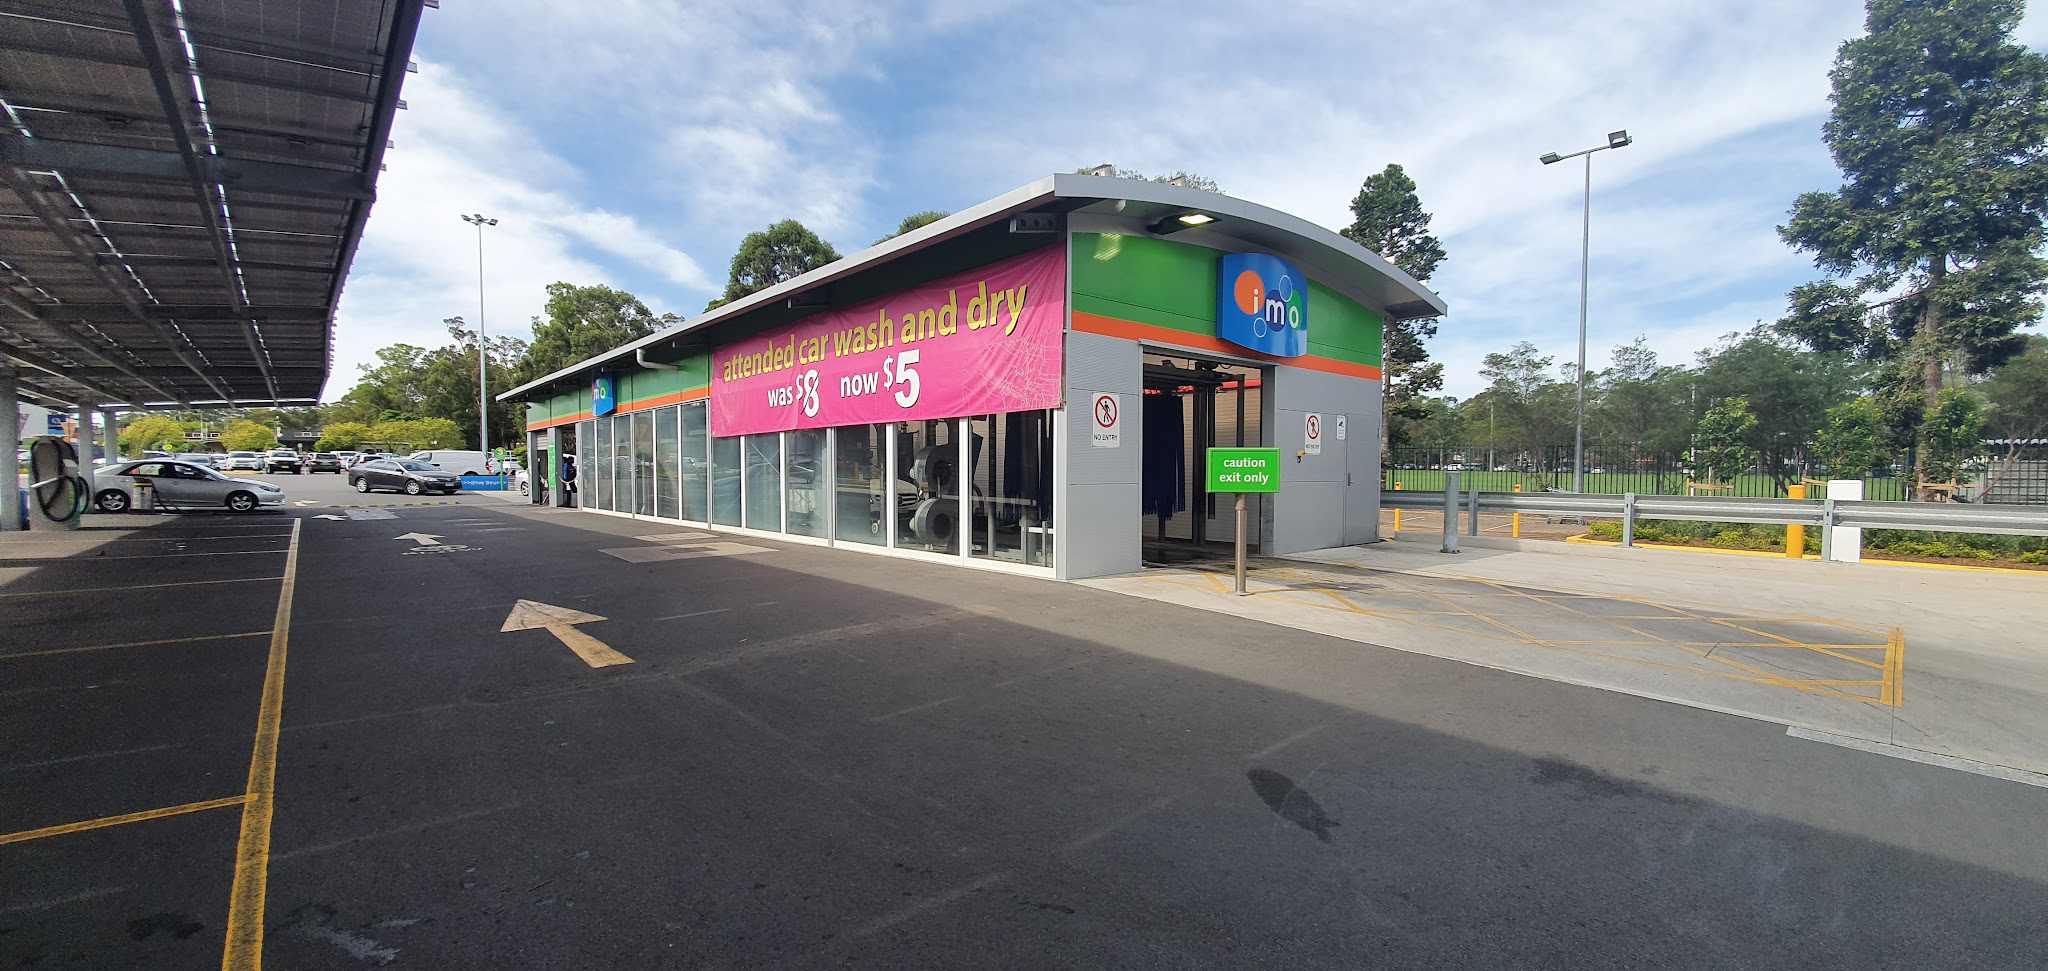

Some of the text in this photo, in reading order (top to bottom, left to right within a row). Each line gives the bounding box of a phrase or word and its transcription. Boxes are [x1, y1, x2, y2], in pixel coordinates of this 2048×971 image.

[1253, 288, 1299, 328] imo
[723, 280, 1028, 383] attended car wash and dry
[767, 348, 921, 418] was $8 now $5
[1219, 471, 1269, 485] exit only
[1223, 457, 1265, 468] caution
